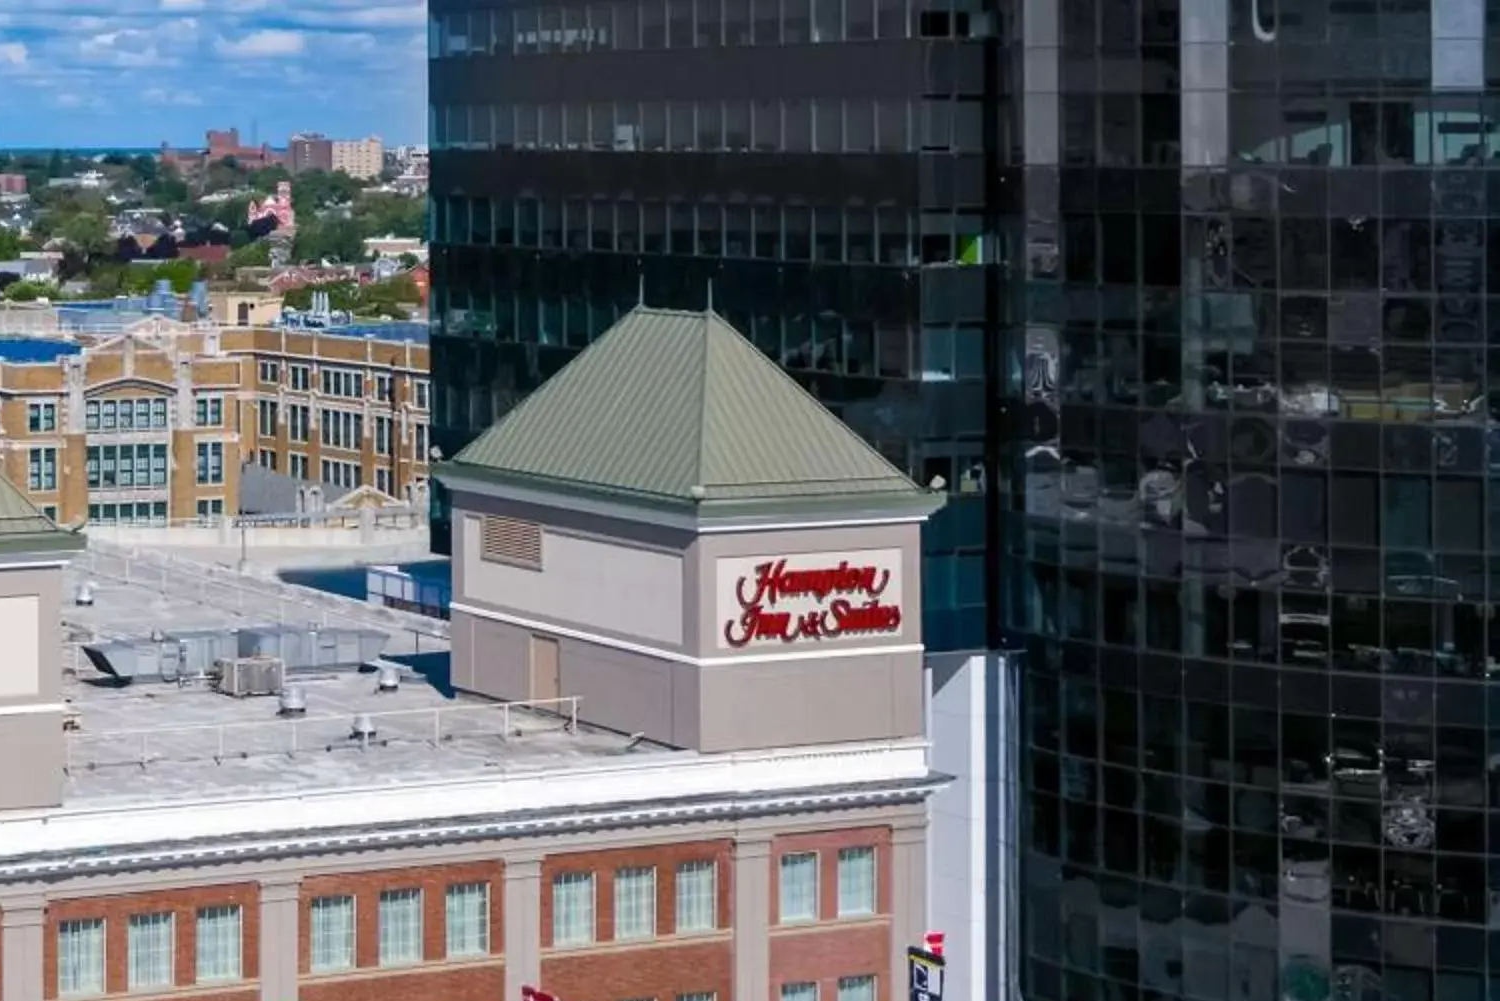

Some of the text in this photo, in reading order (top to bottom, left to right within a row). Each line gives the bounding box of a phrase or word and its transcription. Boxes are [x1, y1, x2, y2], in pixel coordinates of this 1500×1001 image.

[736, 558, 890, 608] Hampton
[724, 604, 801, 648] Inn
[819, 598, 901, 638] Suites
